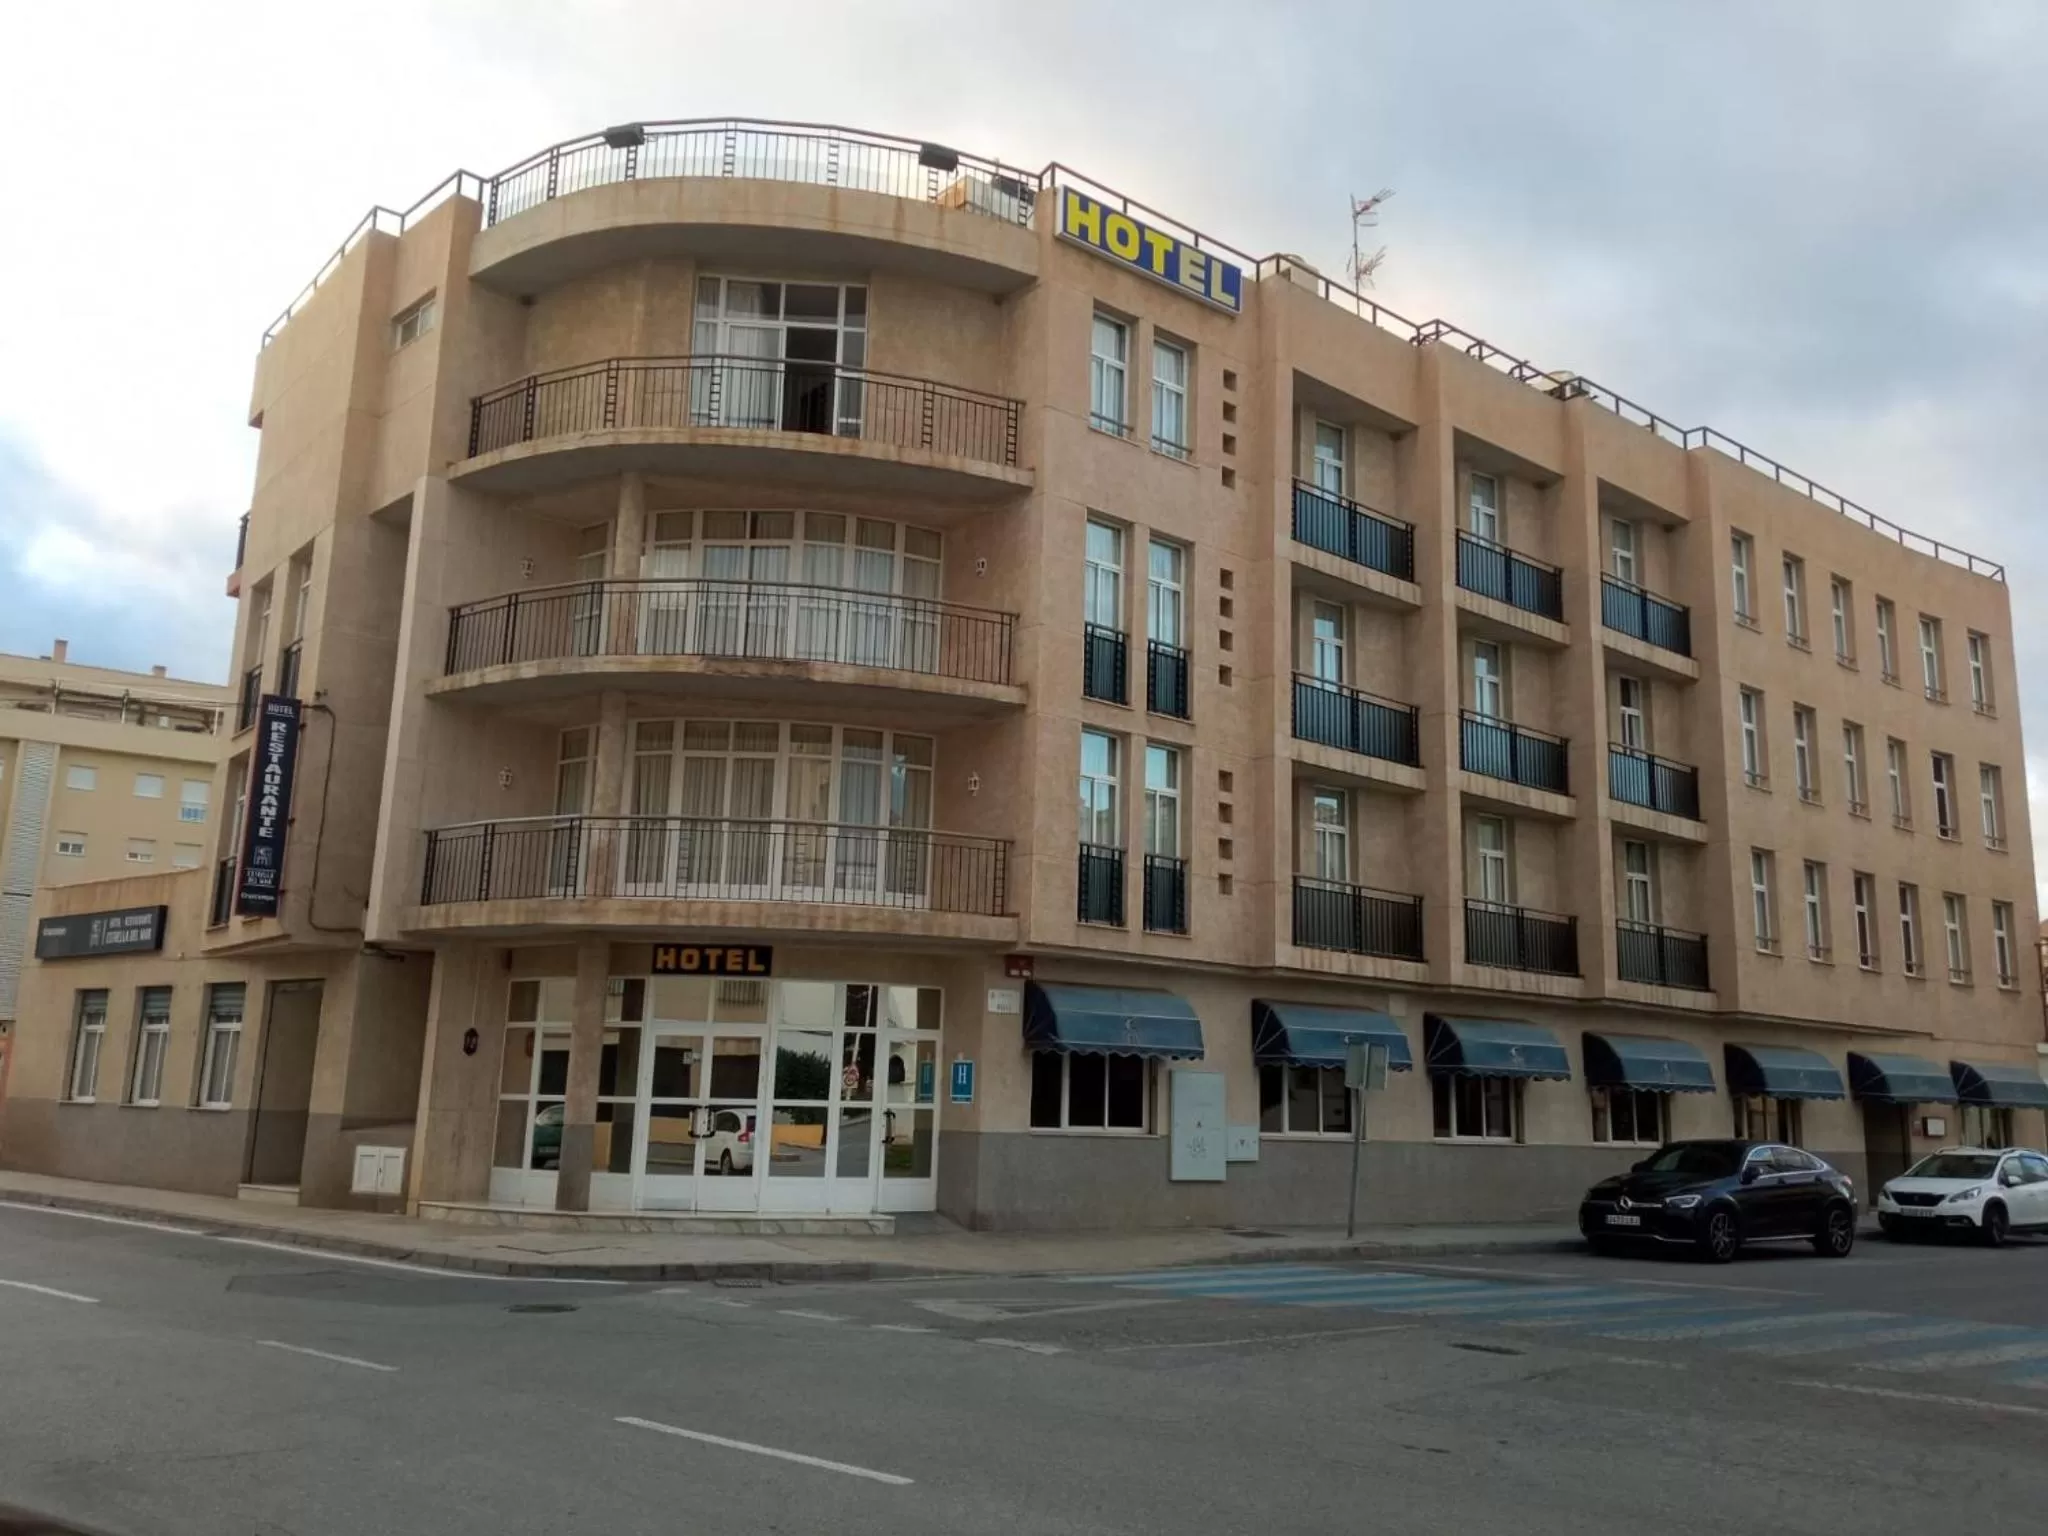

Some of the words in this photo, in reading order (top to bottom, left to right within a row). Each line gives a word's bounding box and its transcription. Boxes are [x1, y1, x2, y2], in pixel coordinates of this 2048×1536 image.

[1067, 191, 1235, 307] HOTEL
[267, 703, 293, 715] HOTEL
[259, 721, 287, 838] RESTAURANTE
[656, 947, 765, 972] HOTEL
[958, 1064, 967, 1084] H
